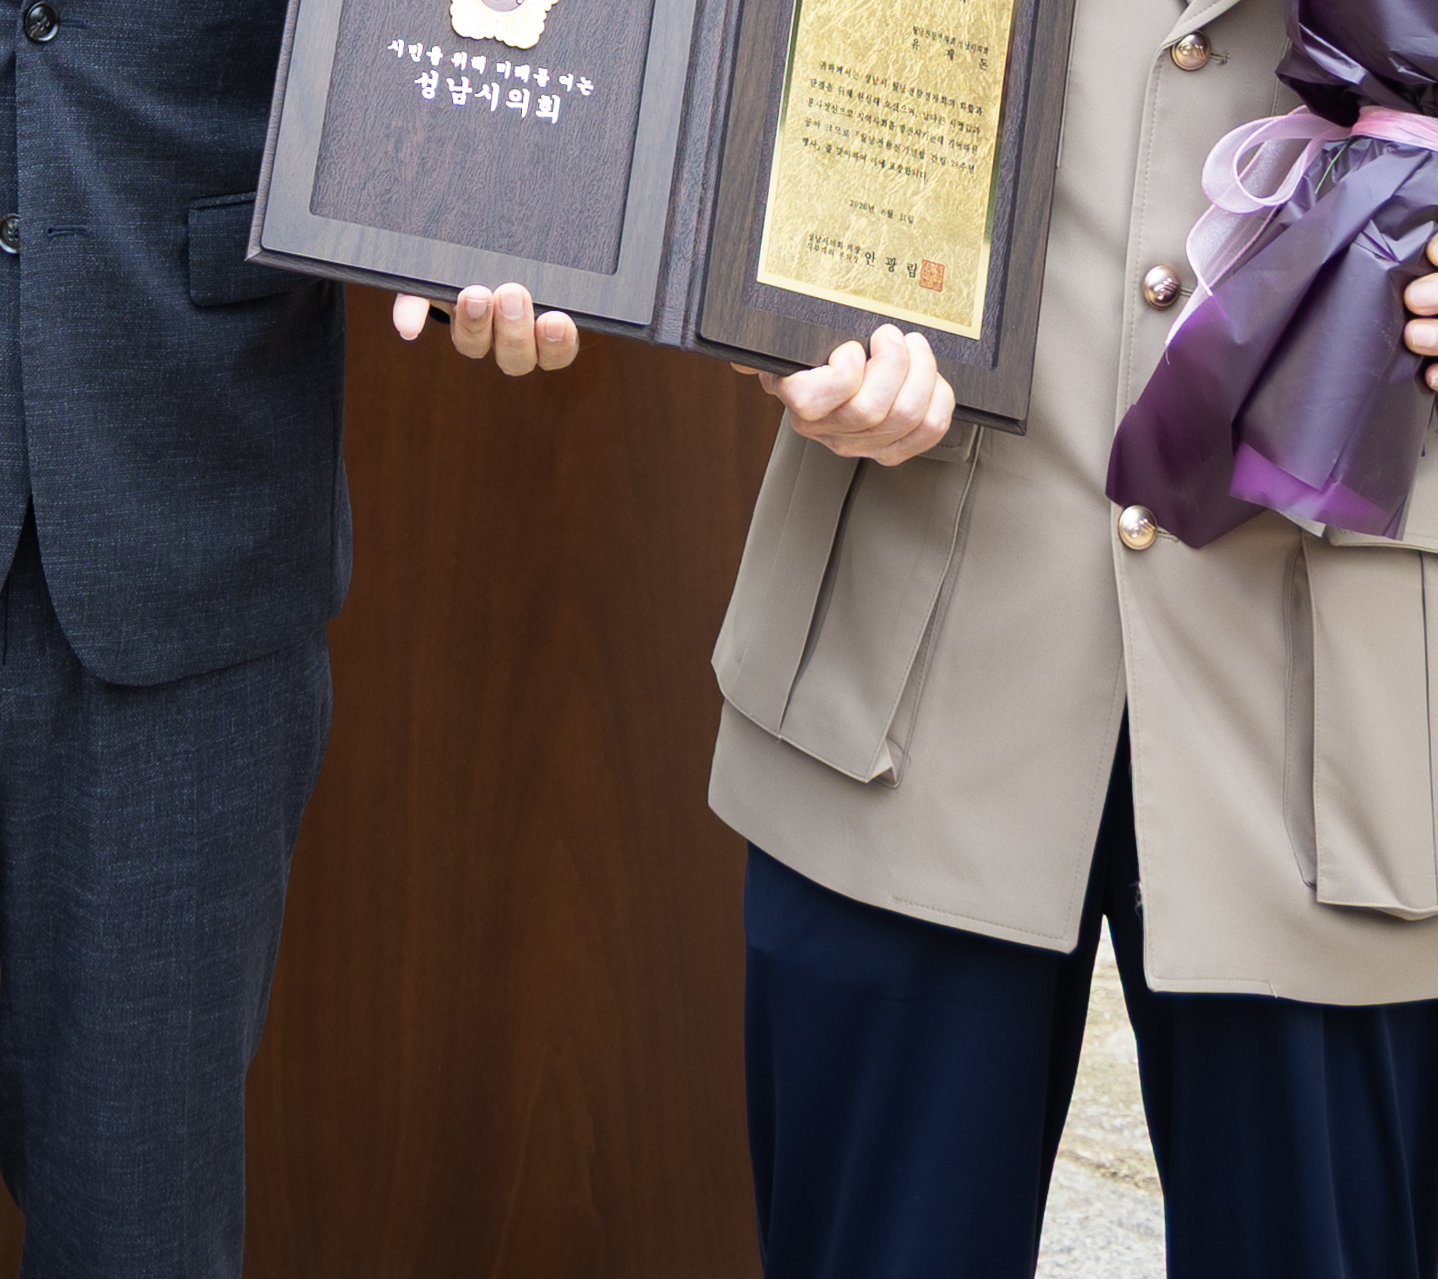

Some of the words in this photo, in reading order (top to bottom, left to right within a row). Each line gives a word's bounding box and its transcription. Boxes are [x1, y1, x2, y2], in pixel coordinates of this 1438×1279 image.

[387, 39, 444, 66] 시민을
[450, 51, 487, 74] 위해
[558, 72, 594, 96] 여는
[414, 70, 561, 124] 성남시의회
